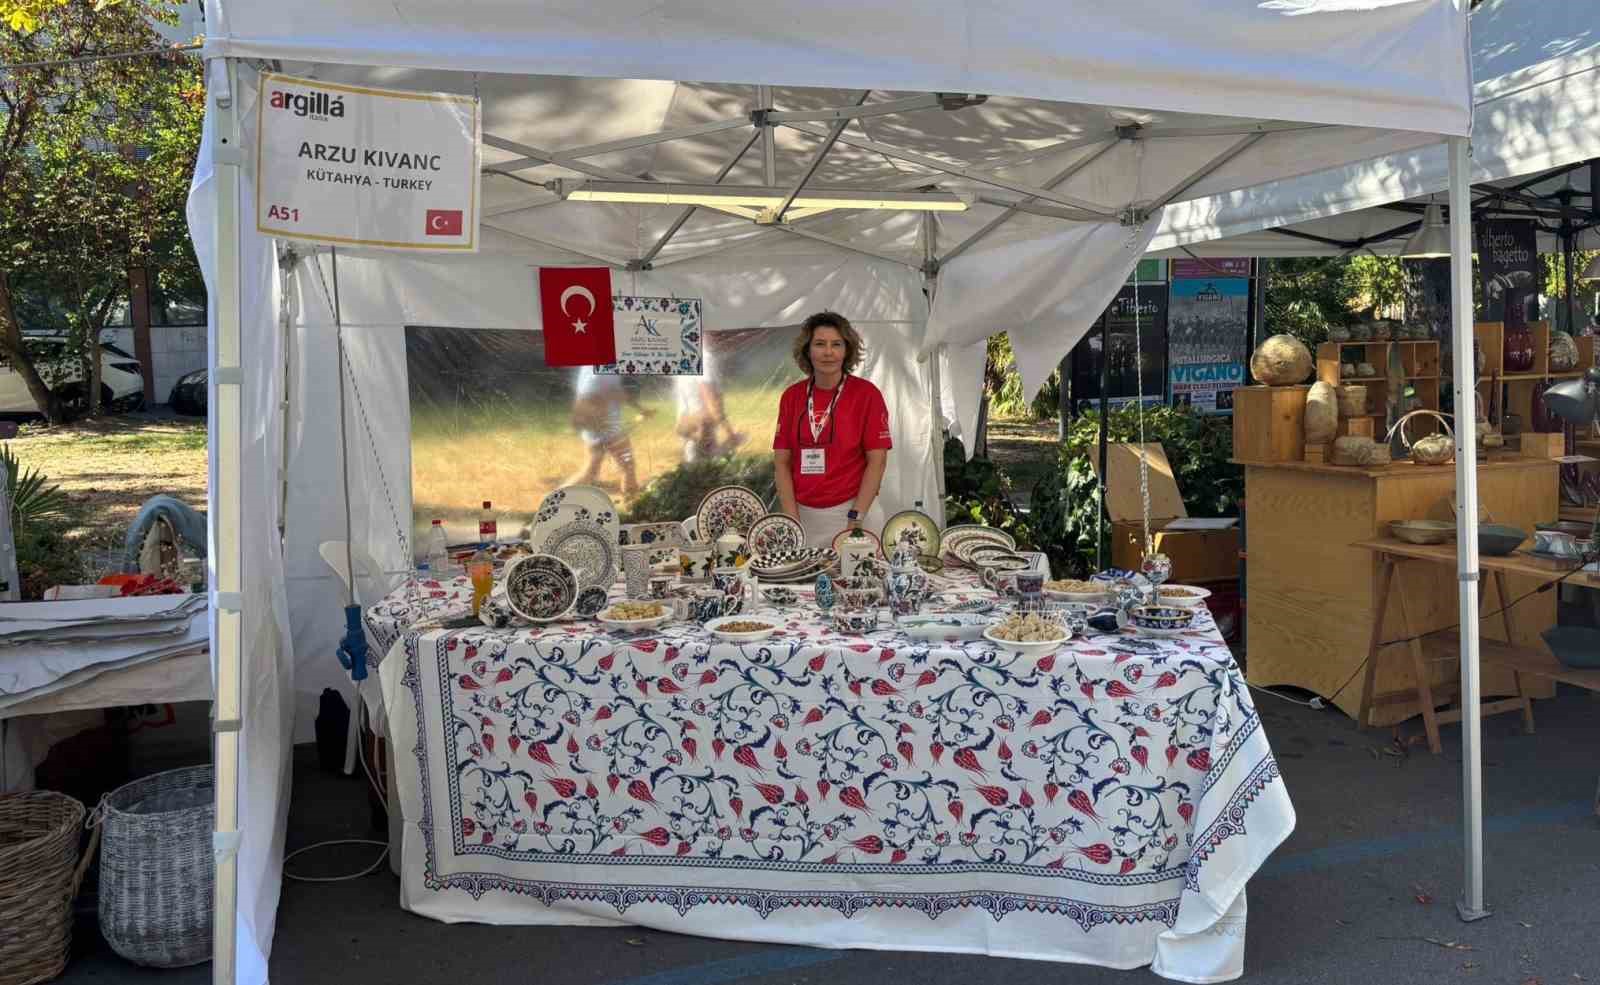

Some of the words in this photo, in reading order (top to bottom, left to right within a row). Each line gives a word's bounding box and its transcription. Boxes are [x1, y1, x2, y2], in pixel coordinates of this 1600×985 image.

[298, 142, 356, 163] ARZU
[363, 150, 441, 171] KIVANC
[306, 168, 372, 187] KÜTAHYA
[383, 177, 433, 191] TURKEY
[267, 204, 300, 222] A51
